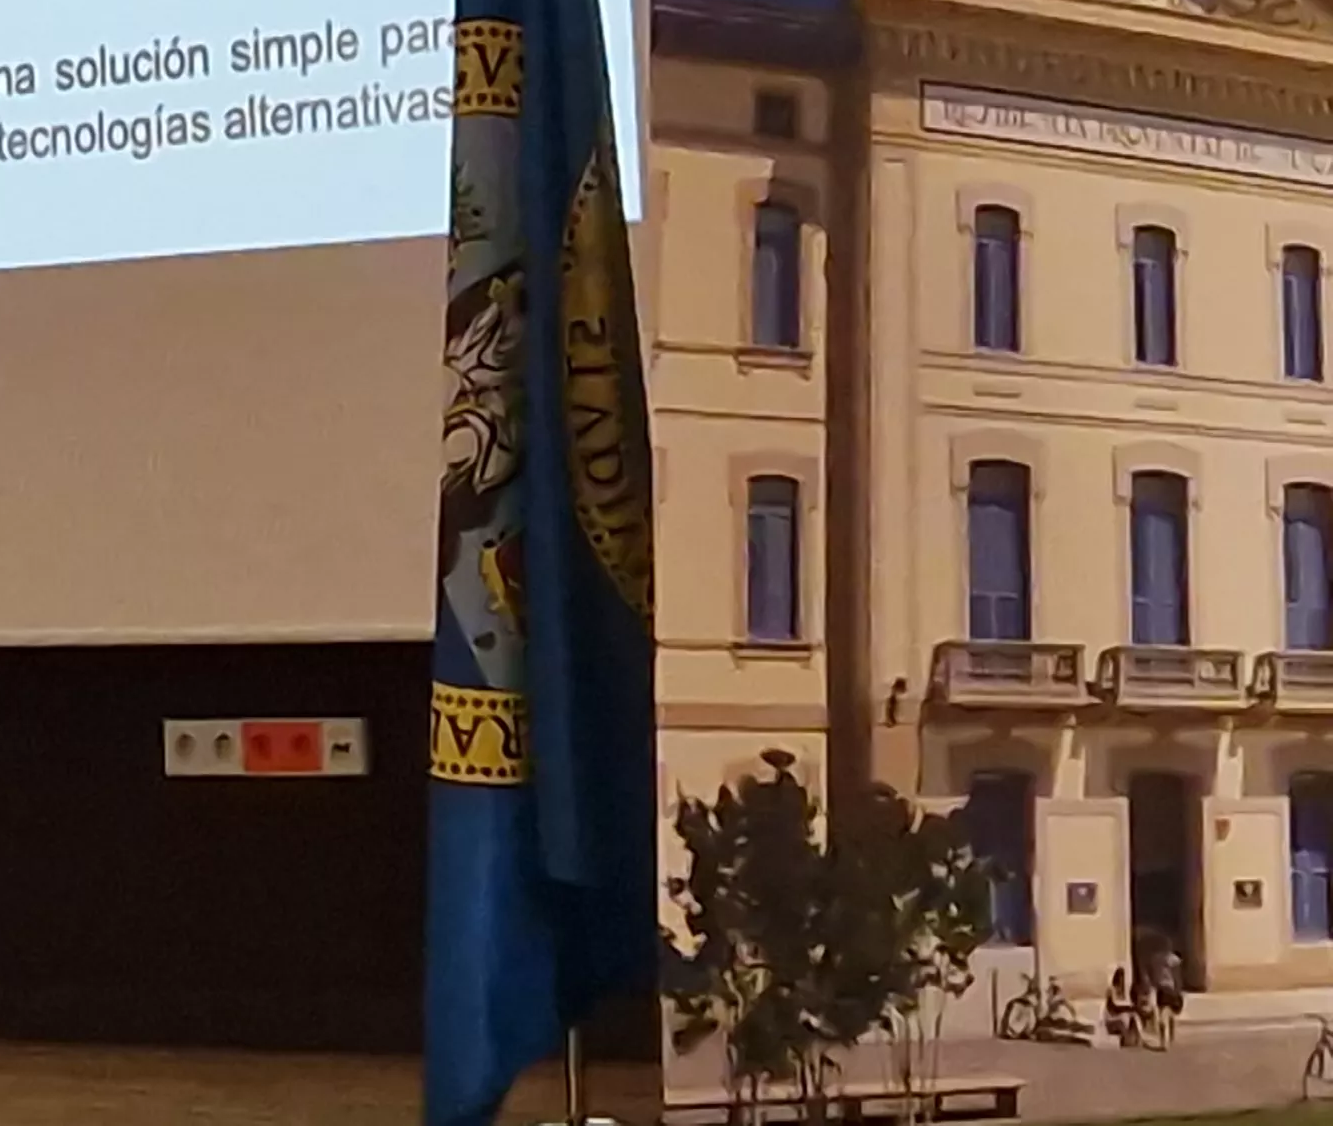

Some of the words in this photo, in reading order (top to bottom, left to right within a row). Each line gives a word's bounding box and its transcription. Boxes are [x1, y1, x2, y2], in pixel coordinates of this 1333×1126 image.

[55, 36, 210, 91] solución
[231, 19, 359, 77] simple
[224, 82, 454, 140] alternativas
